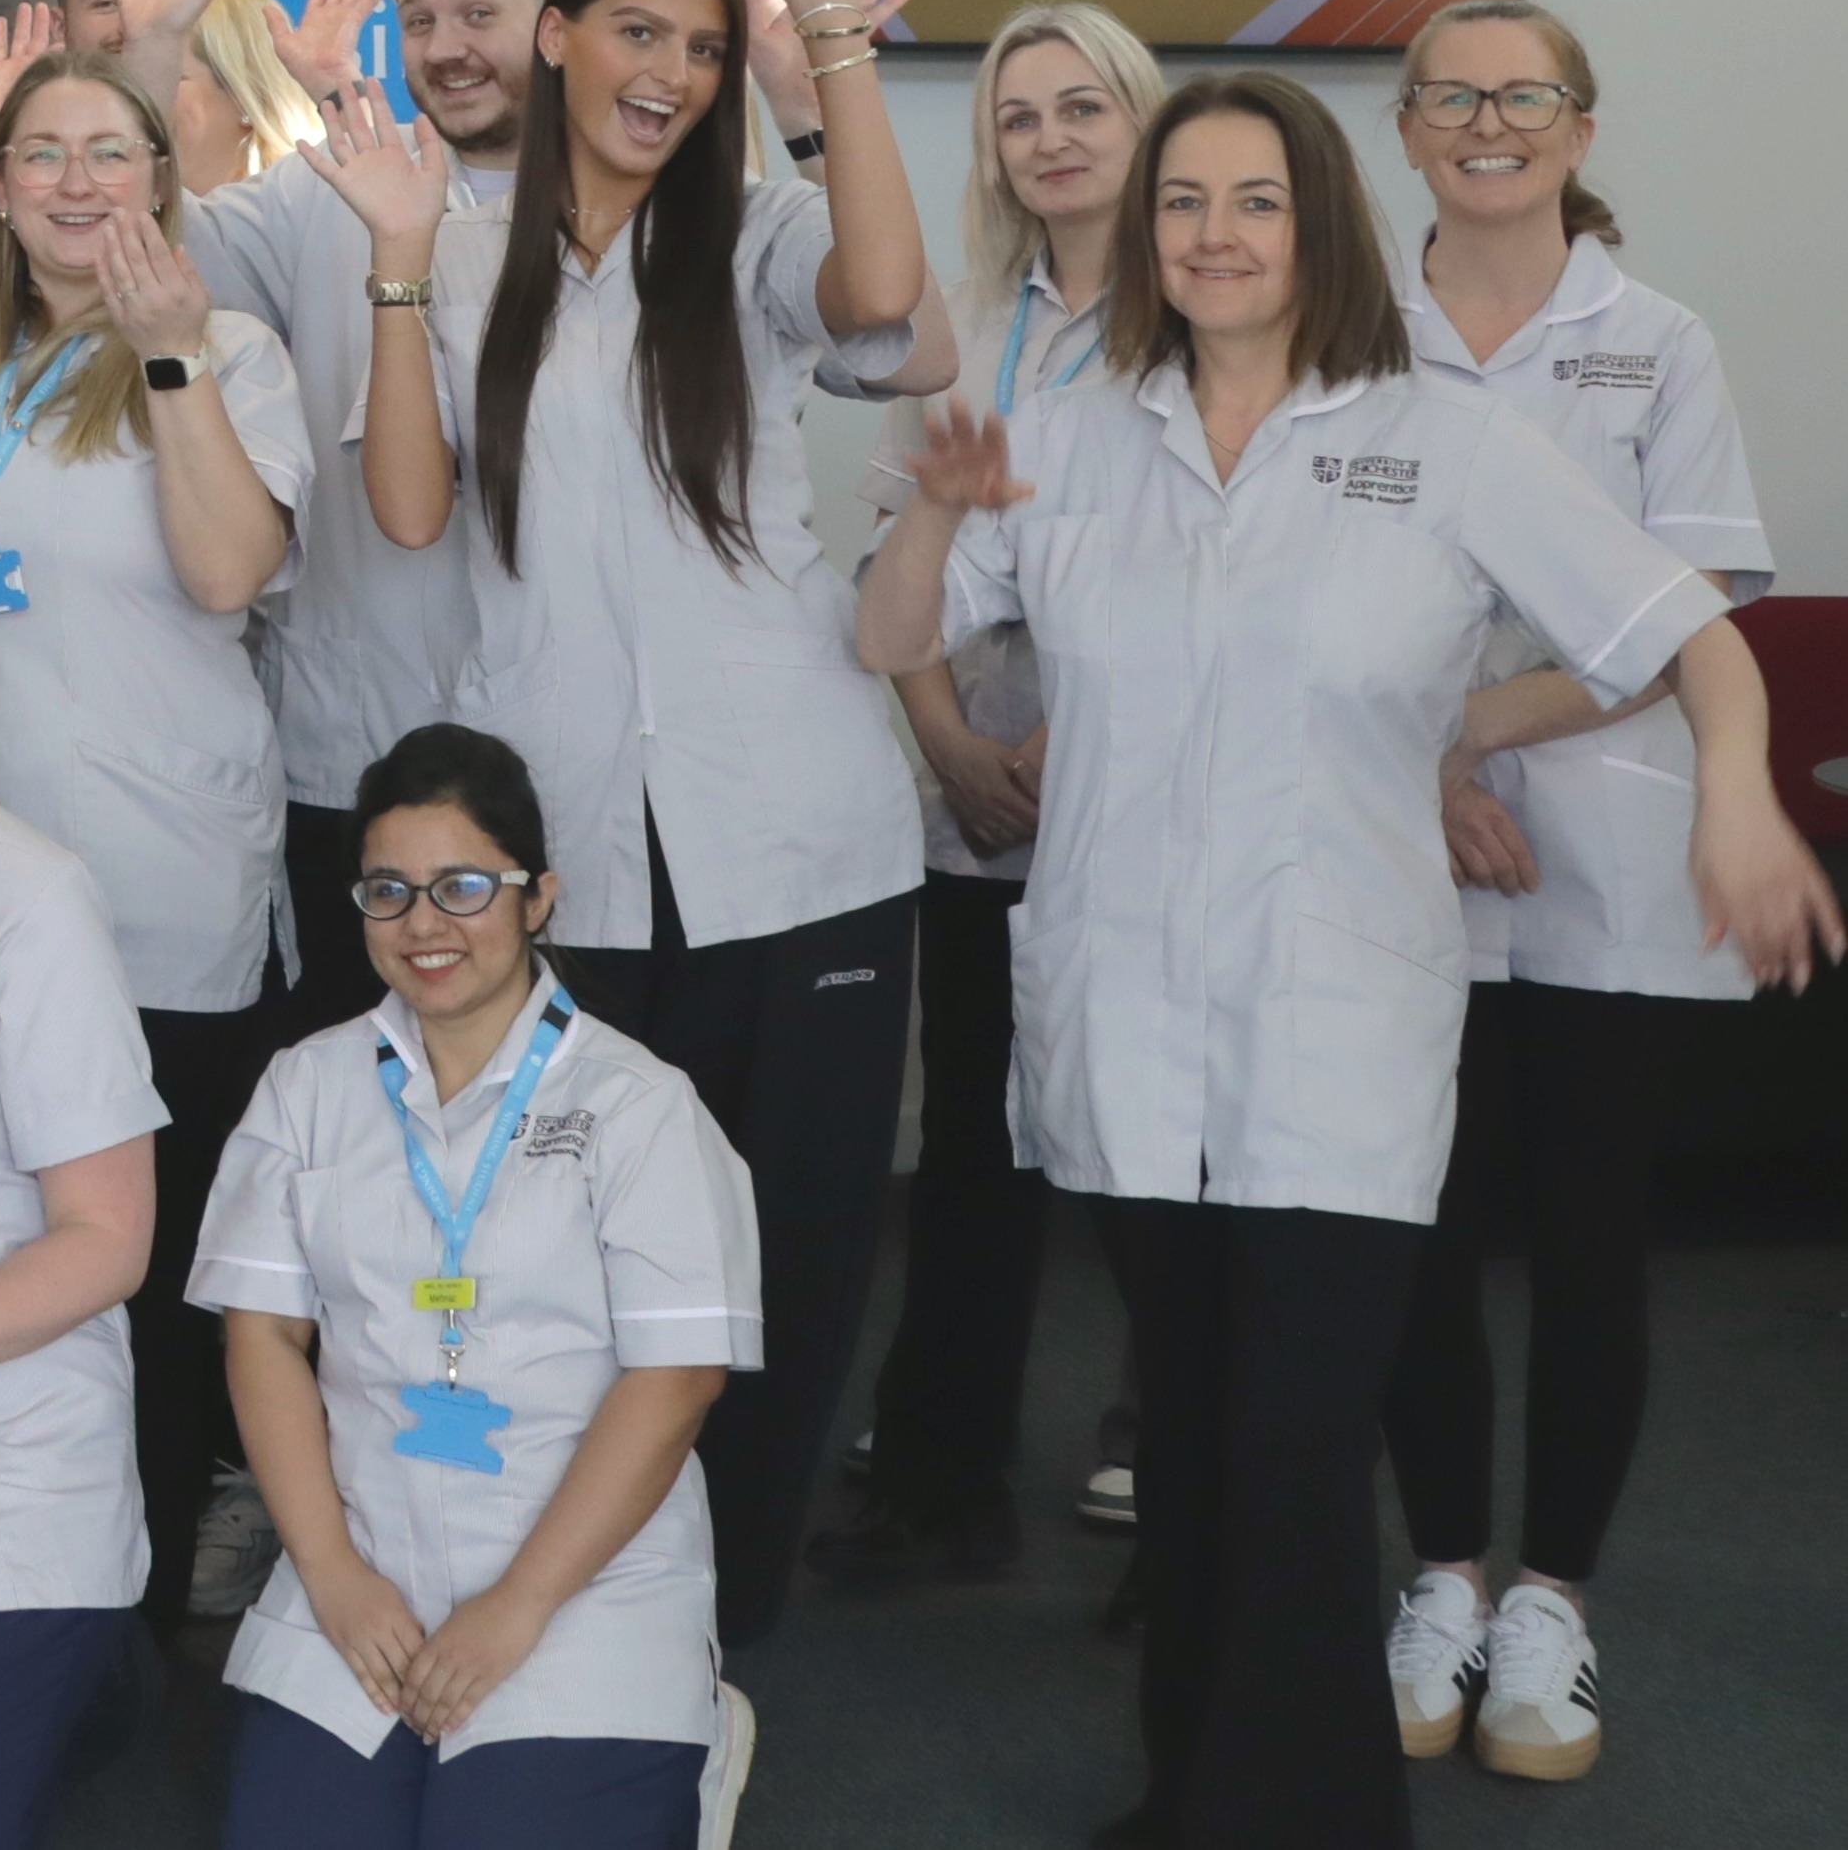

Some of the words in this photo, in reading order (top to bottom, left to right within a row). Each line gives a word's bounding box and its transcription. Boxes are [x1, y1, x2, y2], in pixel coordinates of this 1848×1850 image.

[1579, 371, 1654, 381] Apprentice
[1346, 480, 1417, 495] Apprentice
[465, 1162, 492, 1211] STUDENT
